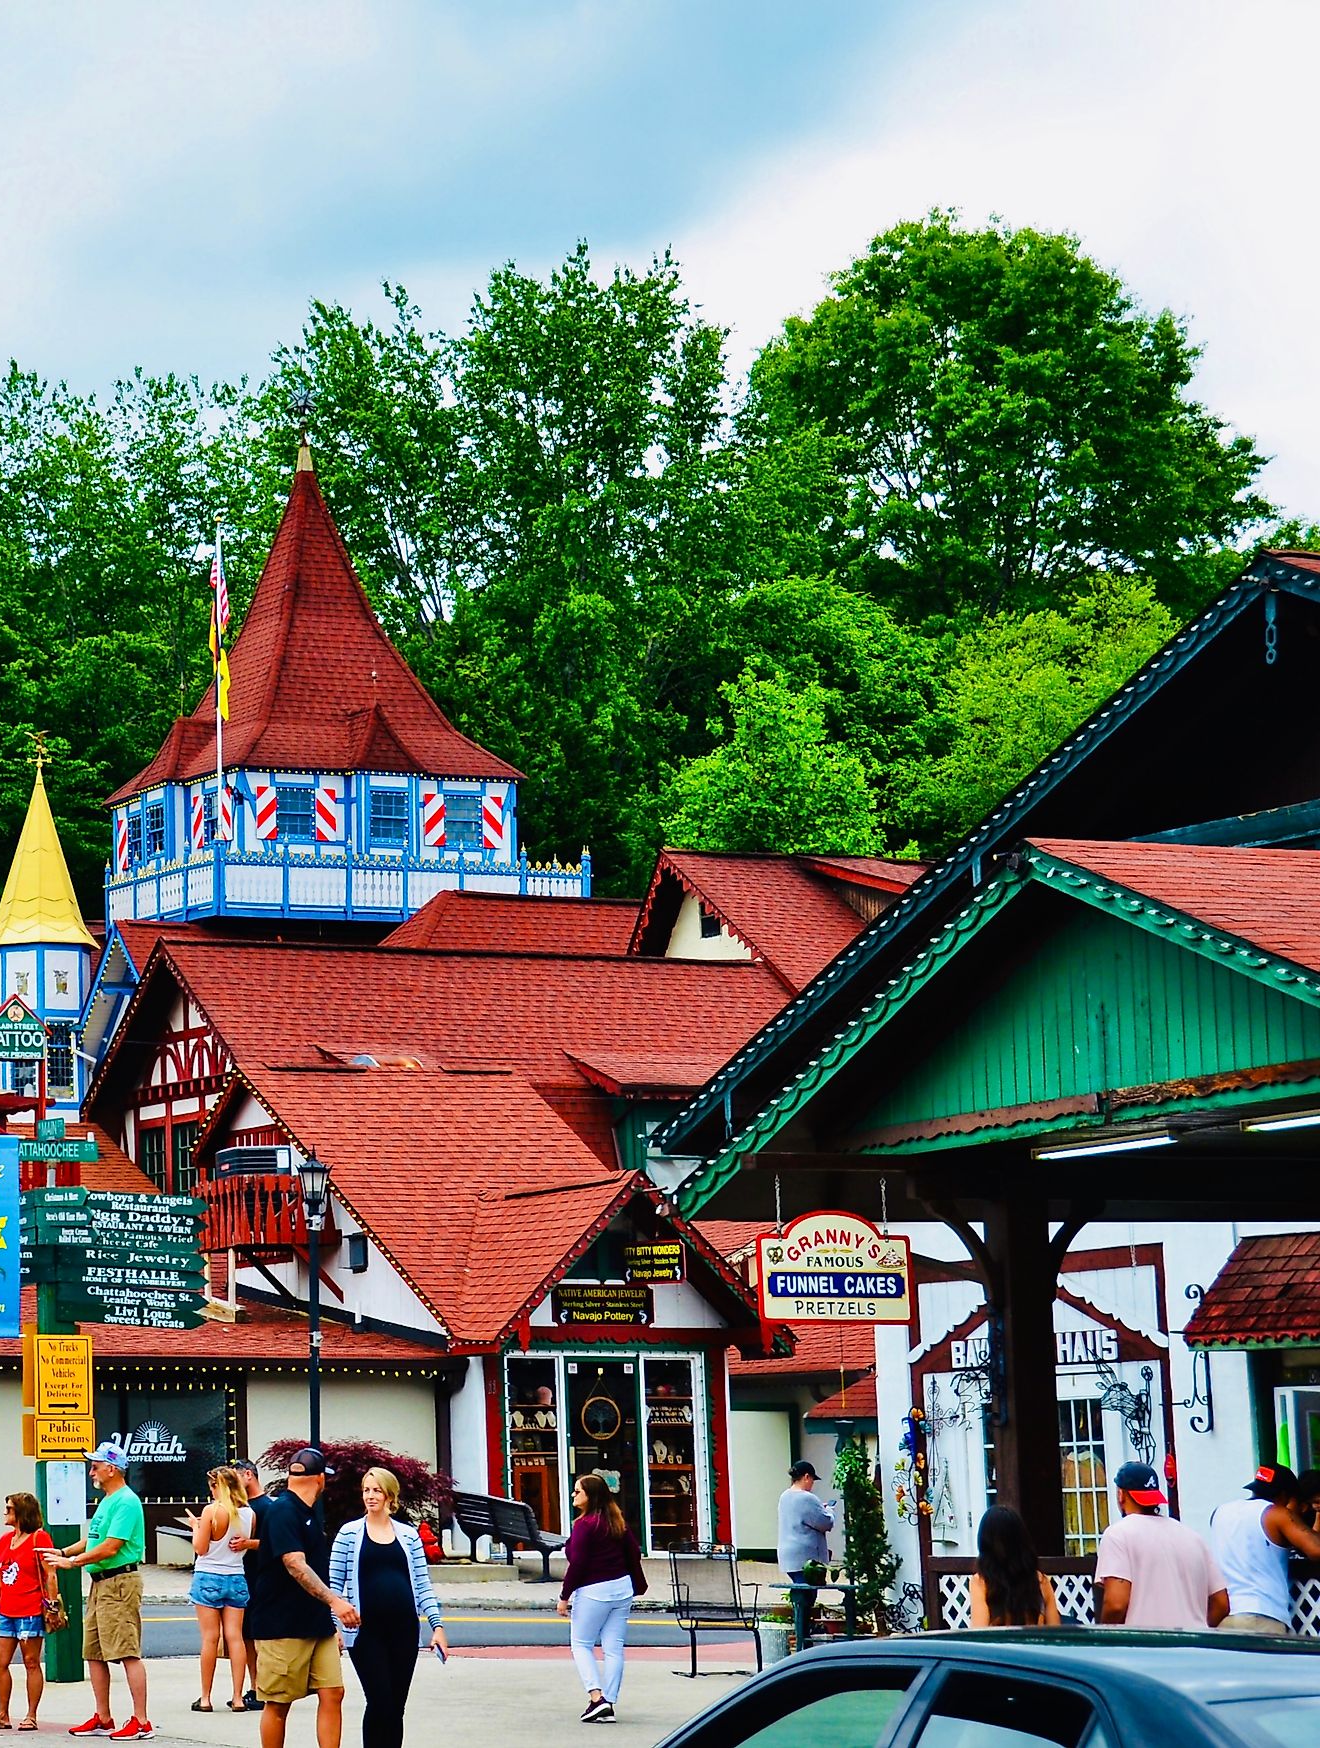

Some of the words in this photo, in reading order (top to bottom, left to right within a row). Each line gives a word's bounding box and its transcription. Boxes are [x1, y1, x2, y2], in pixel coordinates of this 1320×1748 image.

[18, 1142, 79, 1158] ATTAHOOCHEE
[138, 1194, 148, 1204] &
[153, 1195, 192, 1206] Angels
[112, 1202, 170, 1213] Restaurant
[128, 1212, 194, 1226] Daddy's
[86, 1221, 144, 1232] ESTAURANT
[157, 1225, 192, 1234] TAVERN
[96, 1238, 131, 1246] heese
[136, 1240, 158, 1248] Cafe
[124, 1232, 162, 1241] Famous
[168, 1234, 194, 1243] Fried
[636, 1246, 652, 1256] BITTY
[652, 1245, 680, 1256] WONDERS
[787, 1228, 880, 1262] GRANNY'S
[86, 1250, 119, 1260] Rice
[126, 1252, 190, 1268] Jewelry
[806, 1256, 864, 1268] FAMOUS
[87, 1266, 180, 1280] FESTHALLE
[633, 1269, 652, 1279] Navajo
[126, 1278, 186, 1287] OKTOBERFEST
[776, 1275, 838, 1294] FUNNEL
[844, 1276, 896, 1294] CAKES
[87, 1286, 174, 1300] Chattahoochee
[179, 1292, 193, 1302] St.
[558, 1289, 582, 1298] NATIVE
[583, 1289, 617, 1298] AMERICAN
[618, 1290, 646, 1298] JEWELRY
[103, 1296, 141, 1305] Leather
[146, 1299, 176, 1308] Works
[795, 1300, 876, 1315] PRETZELS
[114, 1306, 138, 1317] Livi
[143, 1308, 172, 1320] Lous
[572, 1311, 602, 1322] Navajo
[604, 1311, 634, 1322] Pottery
[104, 1314, 140, 1325] Sweets
[151, 1318, 185, 1328] Treats
[48, 1342, 56, 1352] No
[59, 1342, 78, 1352] Trucks
[1056, 1330, 1118, 1364] HAUS
[41, 1355, 50, 1364] No
[51, 1355, 86, 1364] Commercial
[52, 1368, 76, 1378] Vehicles
[44, 1382, 68, 1390] Except
[49, 1423, 80, 1433] Public
[41, 1434, 90, 1444] Restrooms
[111, 1432, 186, 1455] Yonah
[1144, 1476, 1157, 1488] A
